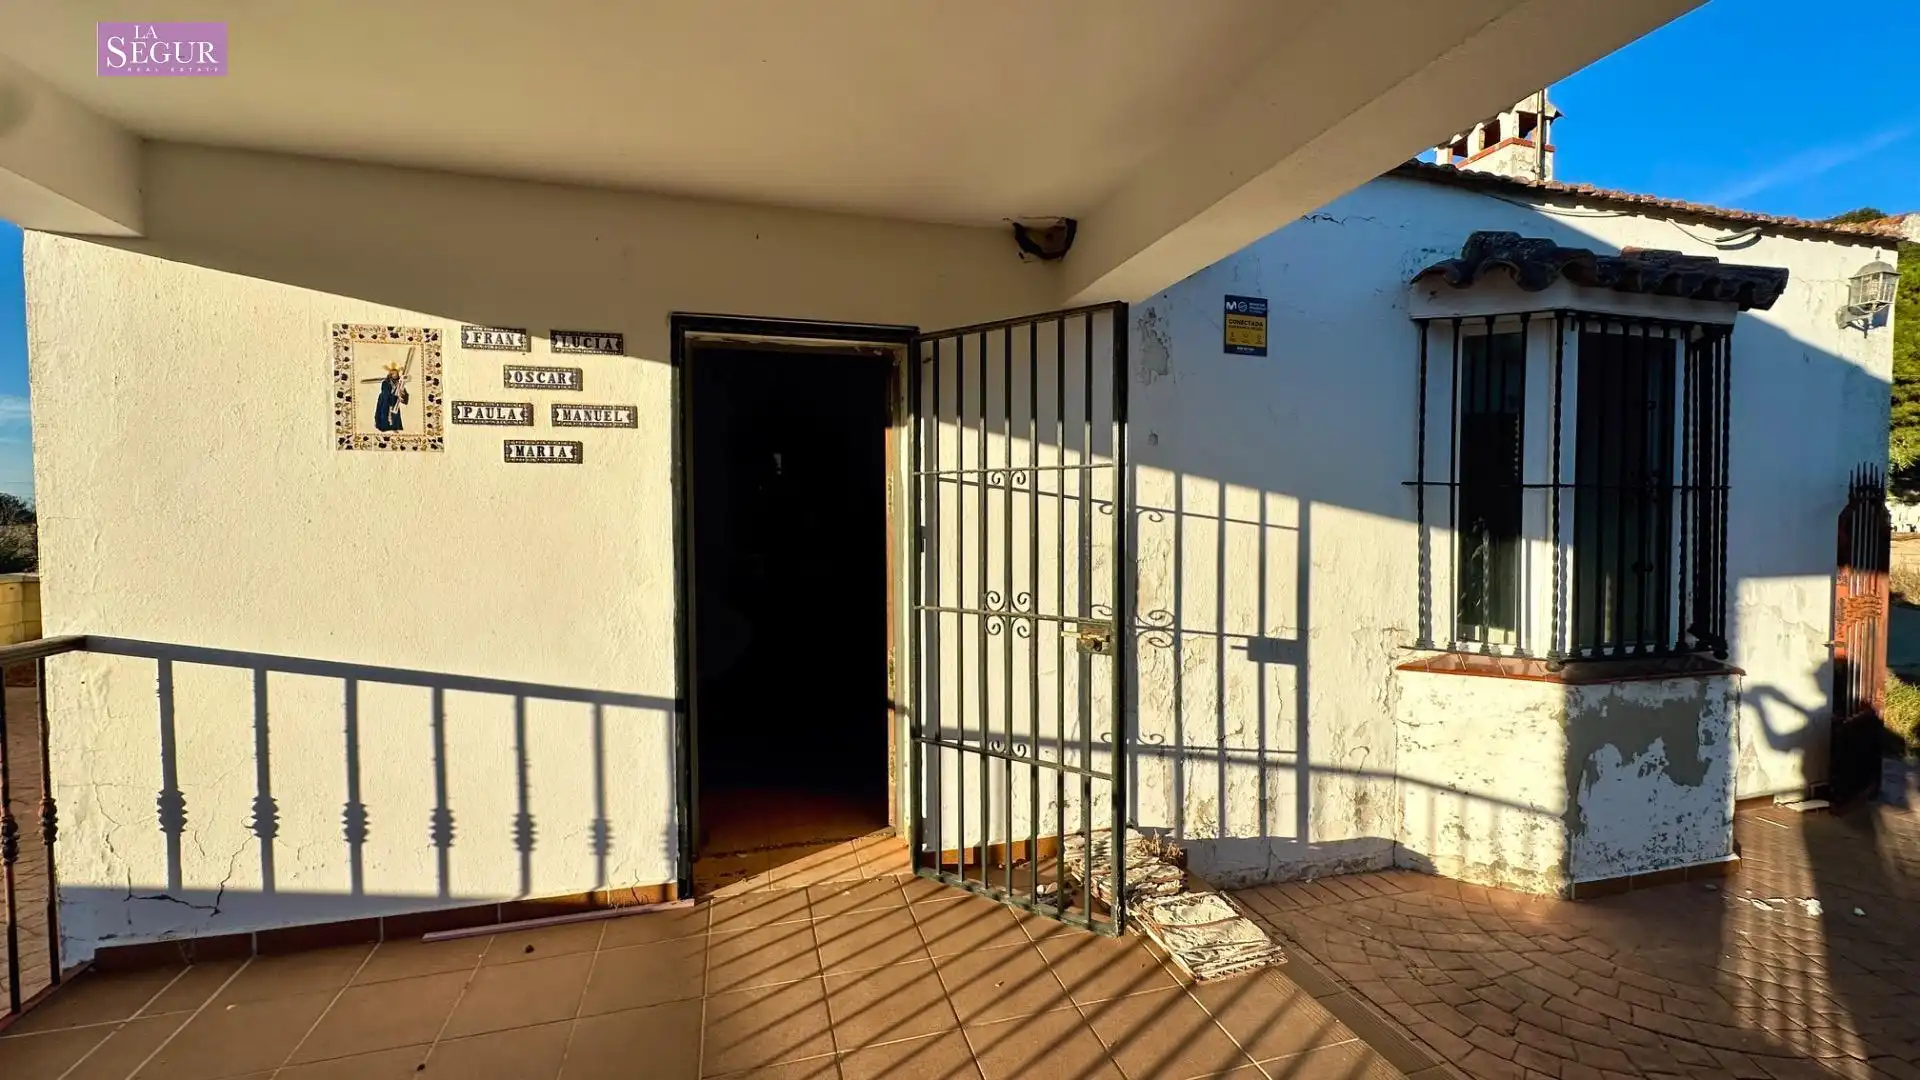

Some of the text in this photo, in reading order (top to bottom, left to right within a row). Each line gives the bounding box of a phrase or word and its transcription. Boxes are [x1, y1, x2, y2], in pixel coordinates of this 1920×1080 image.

[473, 332, 515, 345] FRAN
[562, 336, 613, 350] LUCIA
[514, 371, 567, 384] OSCAR
[463, 407, 517, 419] PAULA
[562, 409, 623, 422] MANUEL
[515, 445, 567, 458] MARIA
